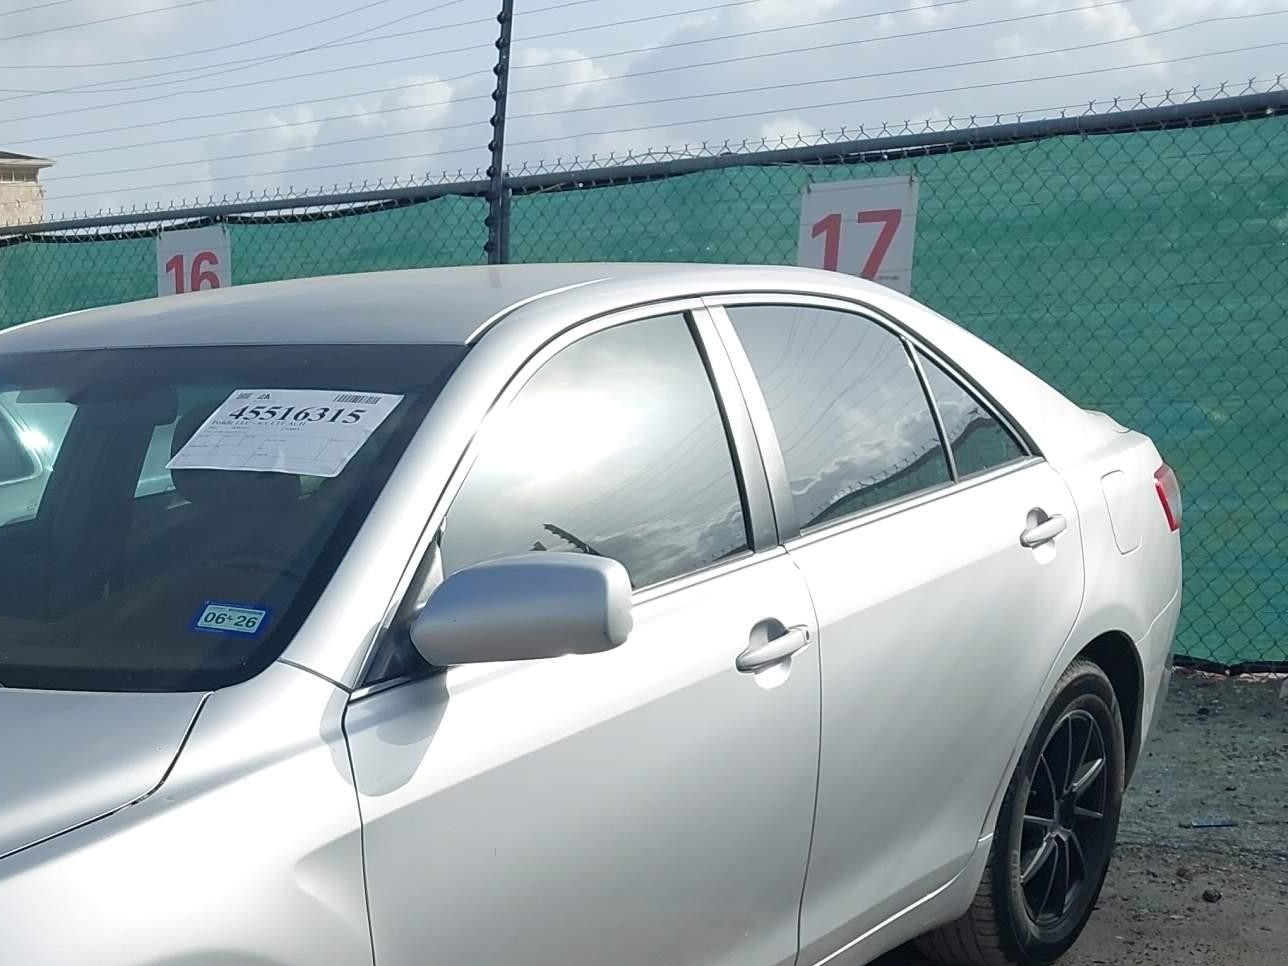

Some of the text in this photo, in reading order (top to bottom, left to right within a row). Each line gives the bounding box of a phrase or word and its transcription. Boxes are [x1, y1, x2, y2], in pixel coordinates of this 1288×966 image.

[811, 208, 902, 281] 17
[165, 251, 220, 294] 16
[229, 404, 366, 424] 45516315
[204, 612, 259, 628] 06 26
